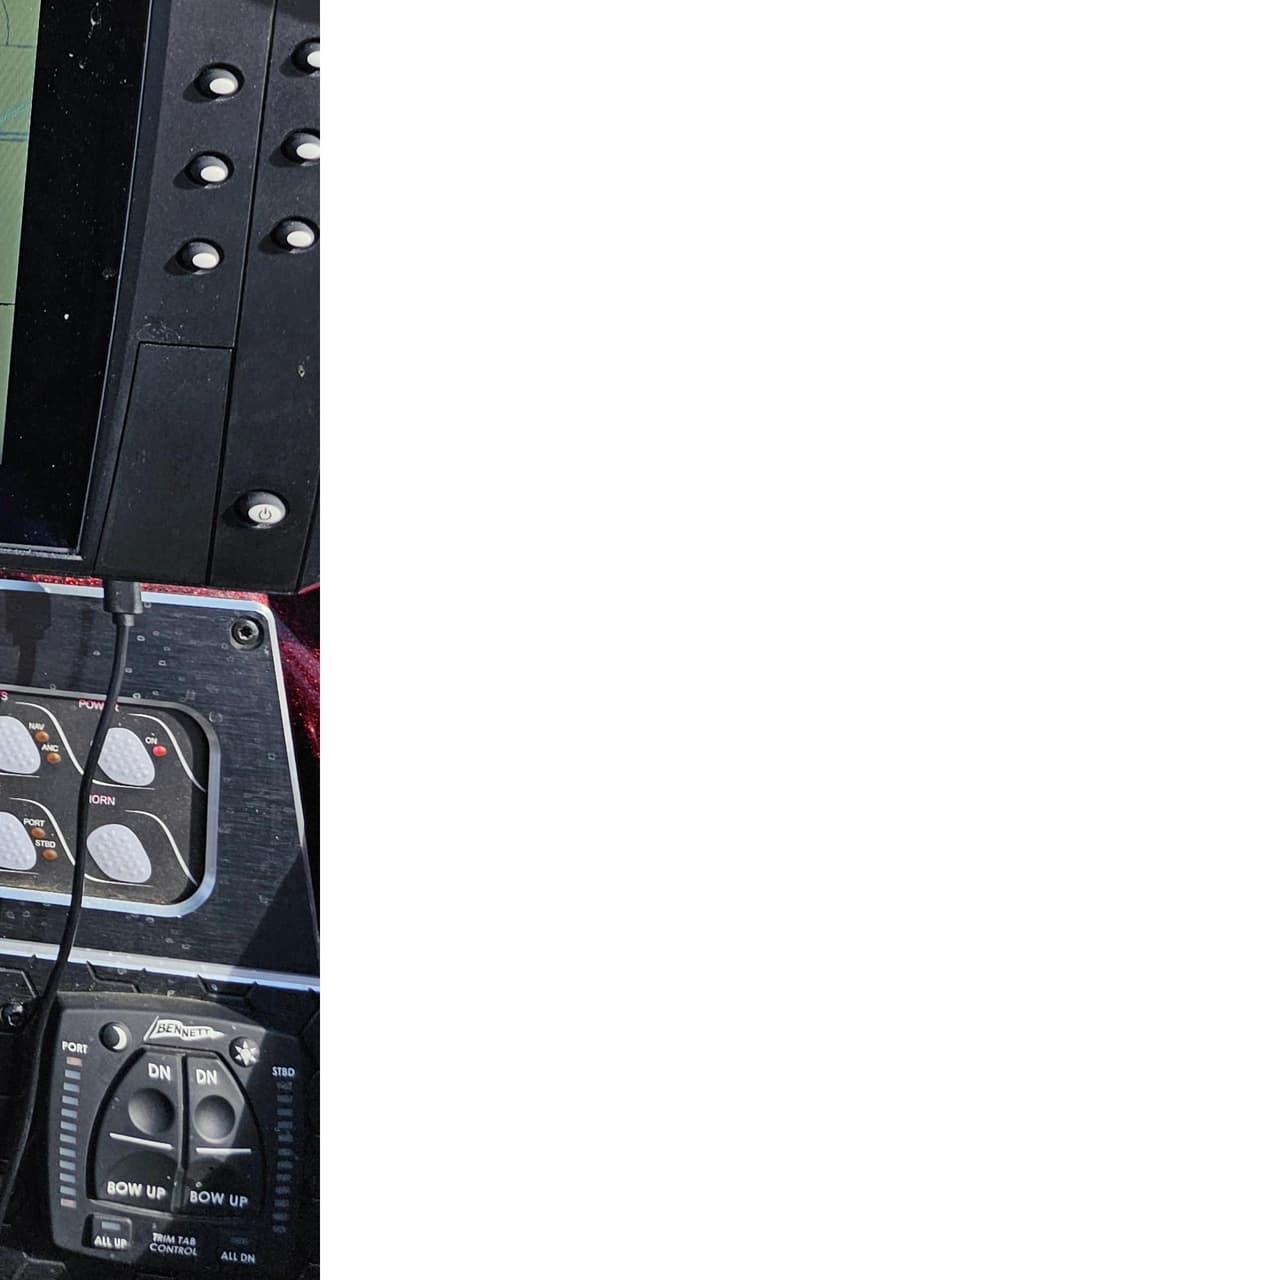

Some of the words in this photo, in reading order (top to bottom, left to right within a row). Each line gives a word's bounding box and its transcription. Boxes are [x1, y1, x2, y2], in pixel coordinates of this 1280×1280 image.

[78, 699, 120, 713] POW
[28, 721, 45, 731] NAV
[145, 736, 158, 745] ON
[41, 743, 60, 753] ANC
[23, 818, 46, 827] PORT
[35, 839, 56, 849] STBD
[157, 1022, 211, 1038] BENNETT
[61, 1040, 88, 1055] PORT
[148, 1063, 171, 1081] DN
[196, 1069, 218, 1085] DN
[271, 1066, 296, 1077] STBD
[107, 1181, 143, 1197] BOW
[146, 1184, 167, 1200] UP
[189, 1190, 224, 1205] BOW
[229, 1195, 249, 1208] UP
[94, 1235, 113, 1248] ALL
[114, 1237, 128, 1249] UP
[152, 1232, 176, 1244] TRIM
[177, 1235, 196, 1246] TAB
[149, 1243, 198, 1256] CONTROL
[221, 1251, 238, 1261] ALL
[240, 1253, 257, 1264] DN
